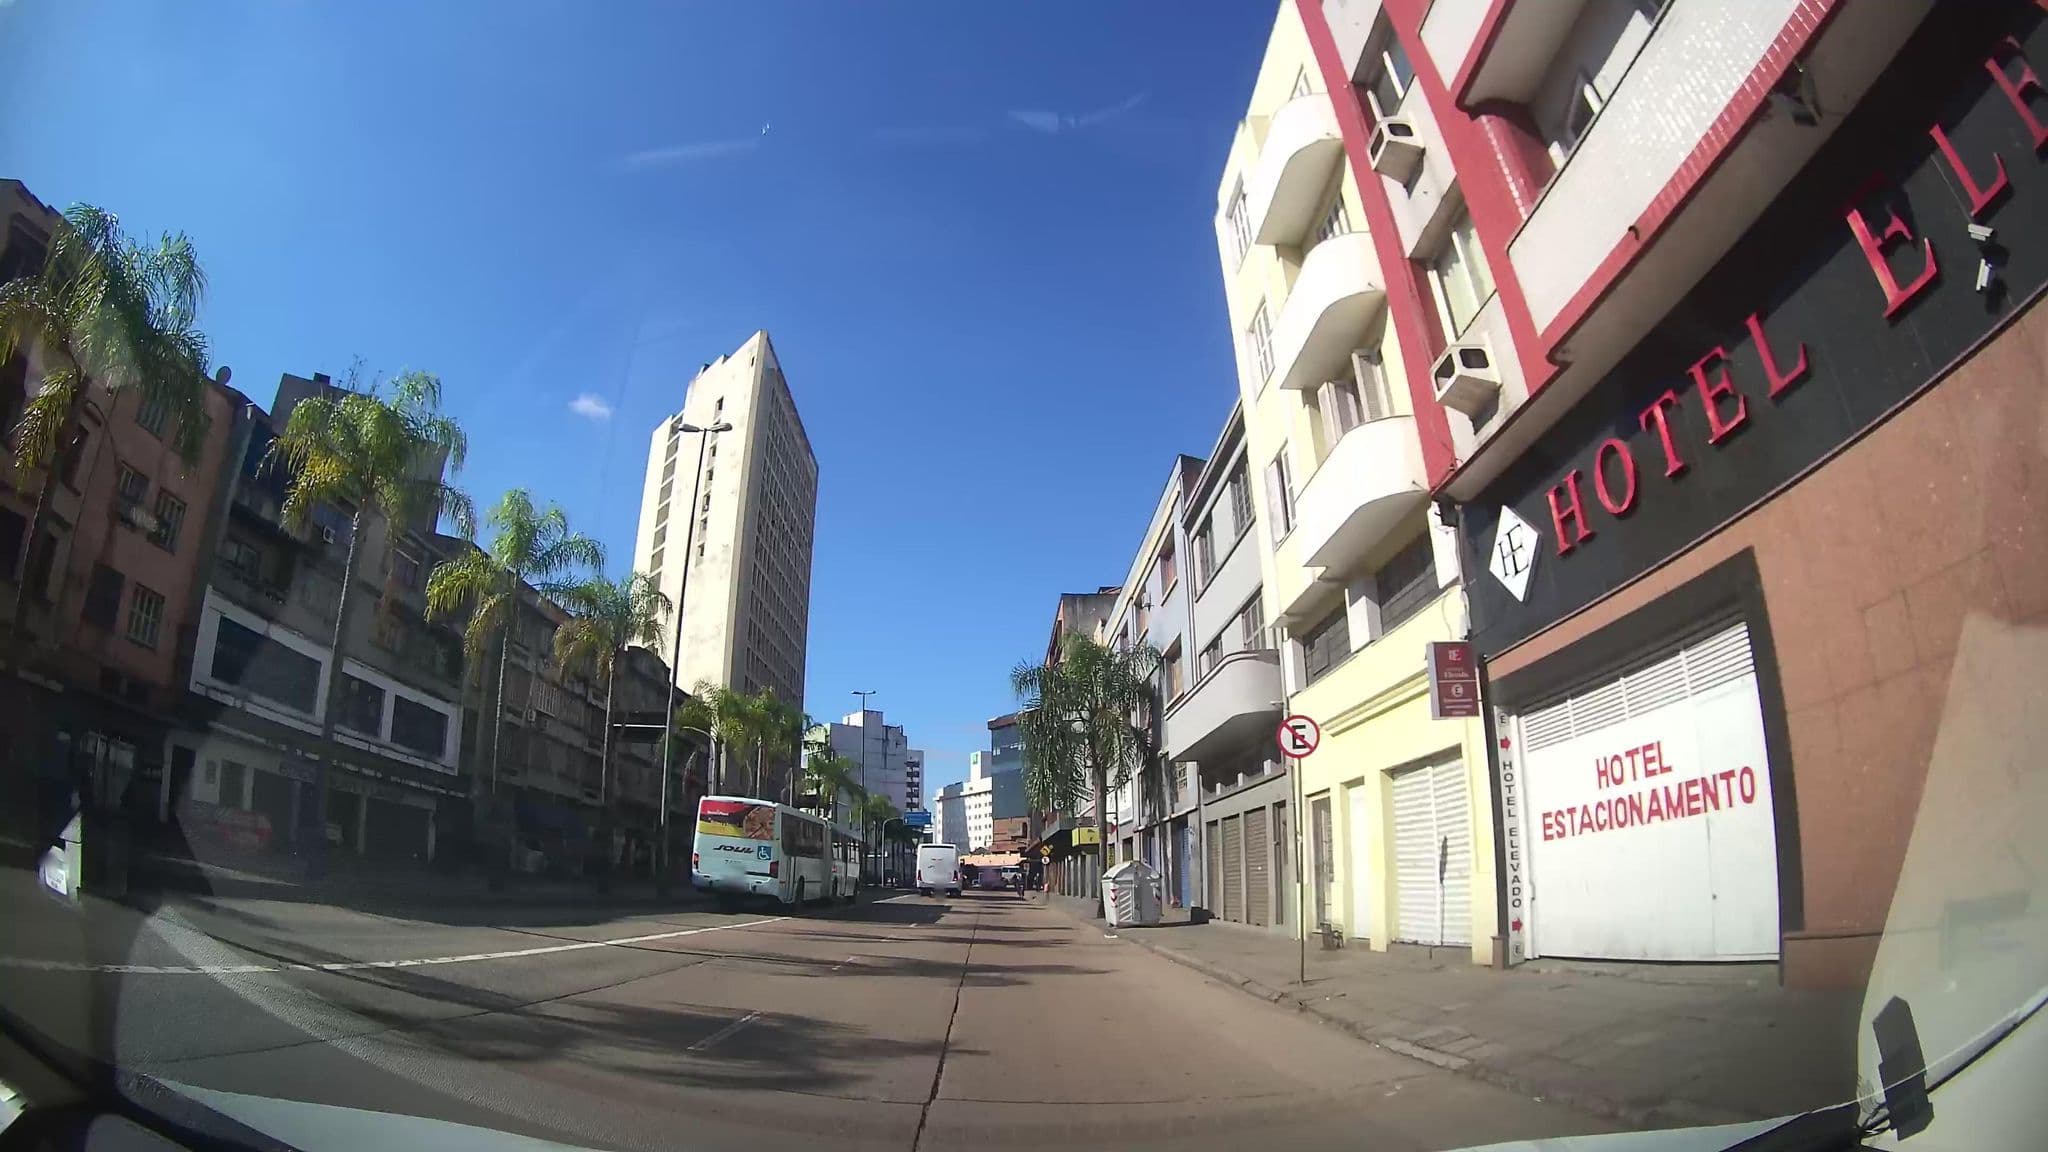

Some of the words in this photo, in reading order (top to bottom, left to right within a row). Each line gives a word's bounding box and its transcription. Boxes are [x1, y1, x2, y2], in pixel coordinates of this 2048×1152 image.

[1544, 312, 1810, 557] HOTEL
[1846, 0, 2048, 319] ELE
[1503, 761, 1516, 819] HOTEL
[1596, 741, 1672, 790] HOTEL
[1542, 766, 1757, 842] ESTACIONAMENTO
[1508, 827, 1522, 909] ELEVADO
